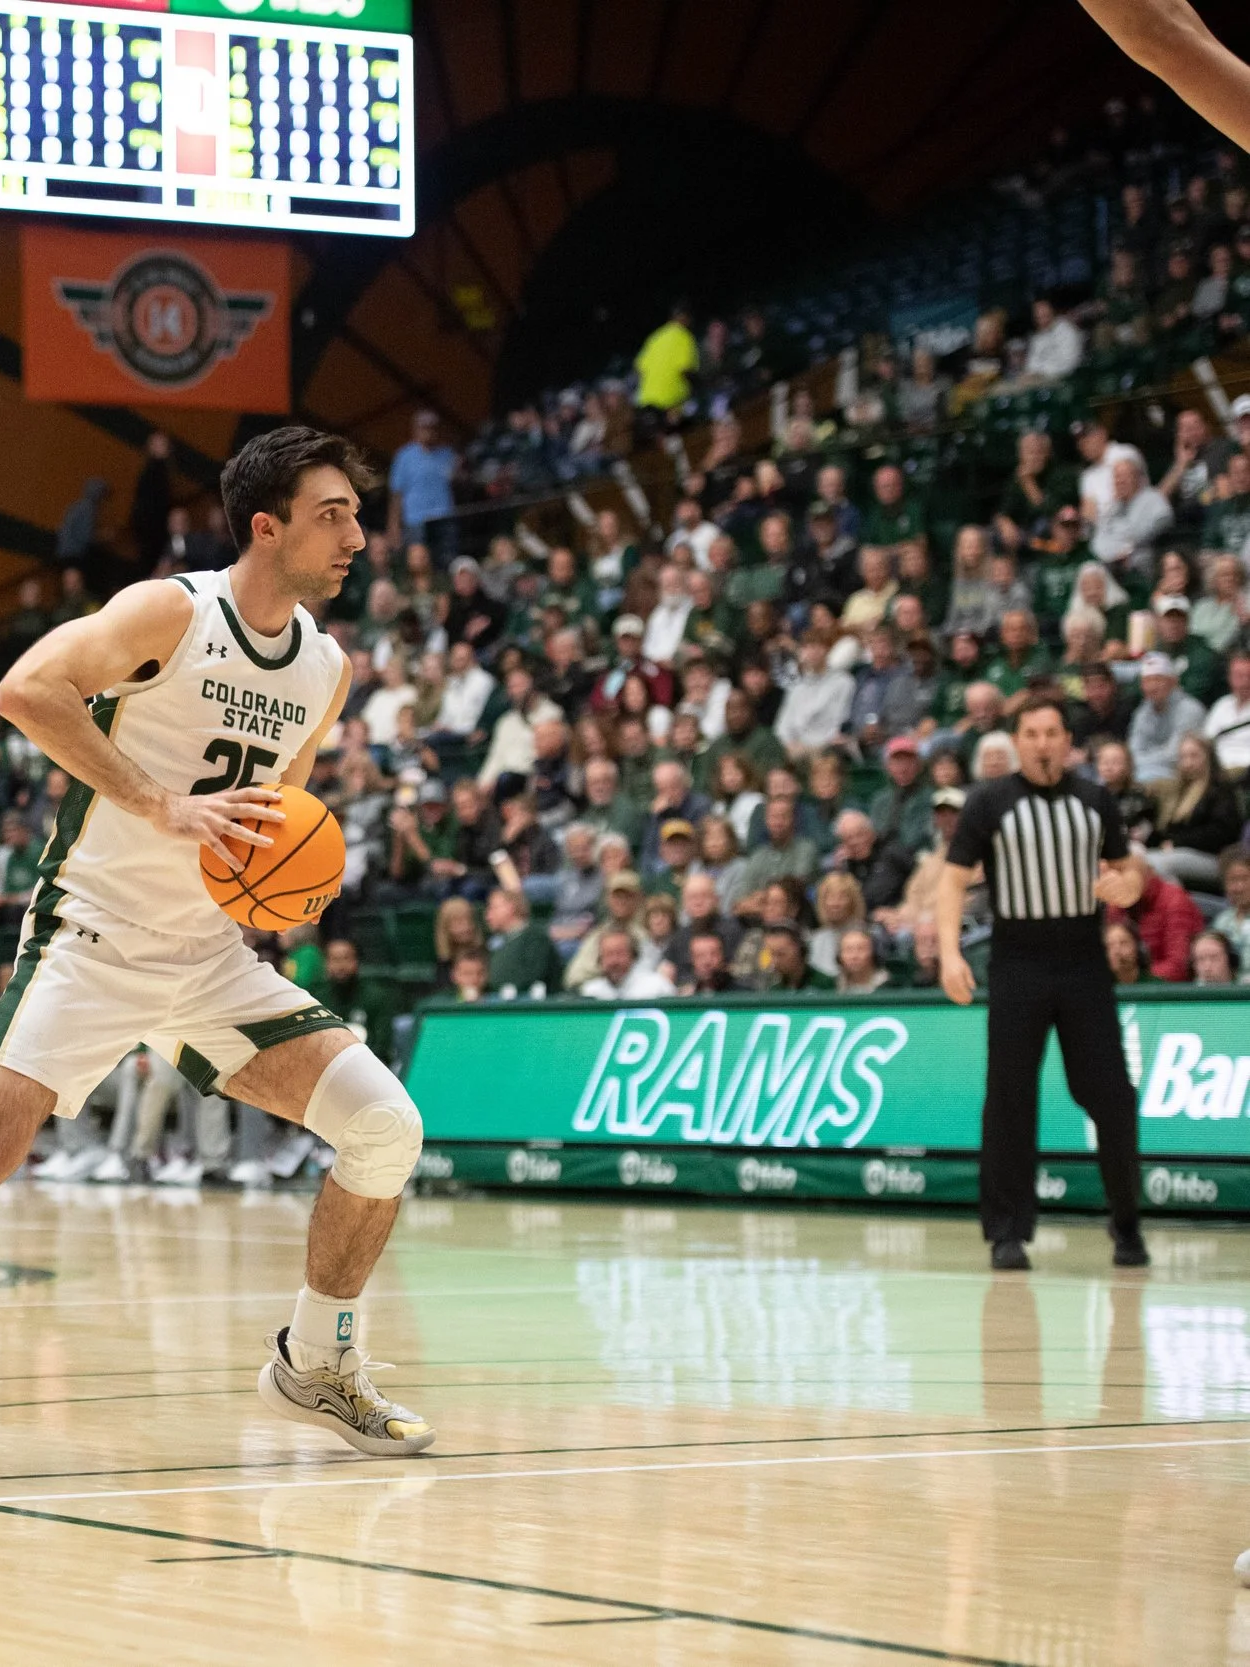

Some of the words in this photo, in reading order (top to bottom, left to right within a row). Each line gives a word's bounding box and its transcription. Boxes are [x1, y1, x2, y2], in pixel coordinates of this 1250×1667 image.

[201, 678, 306, 726] COLORADO
[222, 708, 284, 741] STATE
[571, 1008, 909, 1149] RAMS
